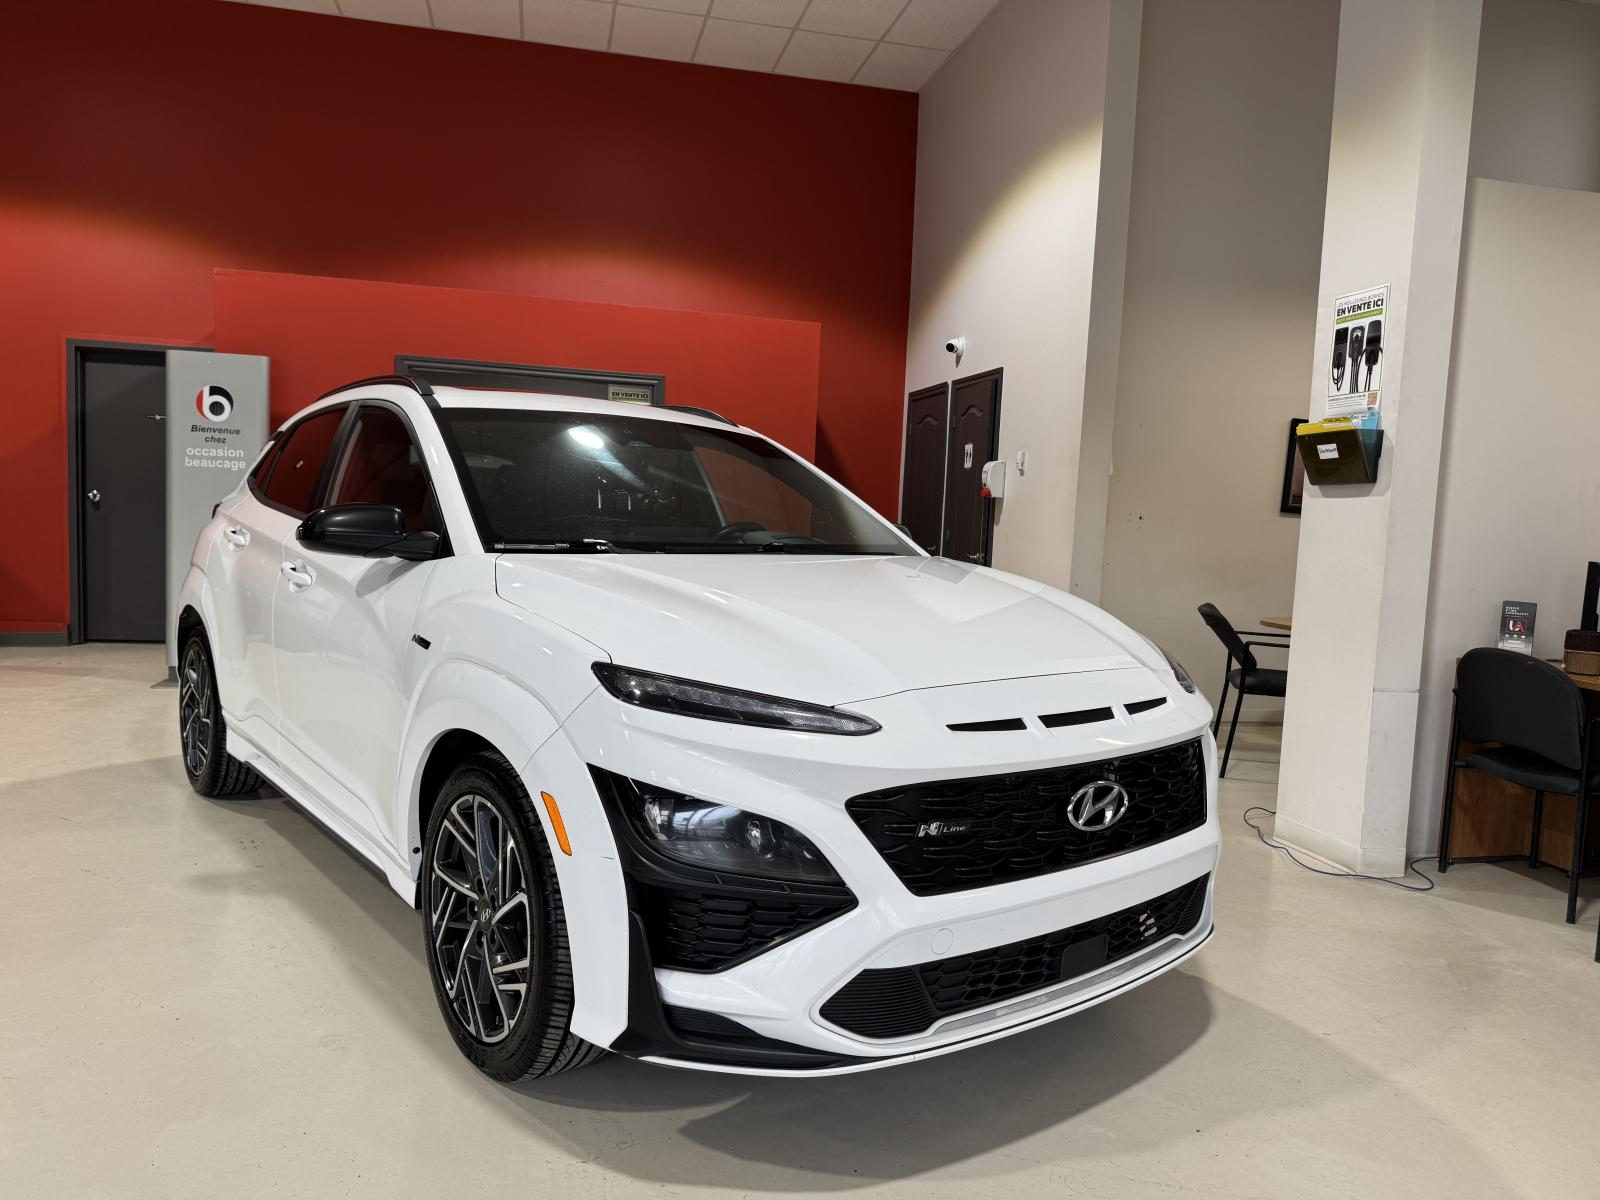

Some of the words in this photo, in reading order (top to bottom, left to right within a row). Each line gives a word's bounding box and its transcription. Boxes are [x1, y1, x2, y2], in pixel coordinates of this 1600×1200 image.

[1337, 307, 1346, 317] EN
[1347, 301, 1371, 315] VENTE
[1373, 298, 1384, 309] ICI
[190, 424, 241, 435] Bienvenue
[204, 435, 227, 444] chez
[186, 447, 244, 457] occasion
[185, 457, 246, 471] beaucage
[943, 825, 966, 833] Line
